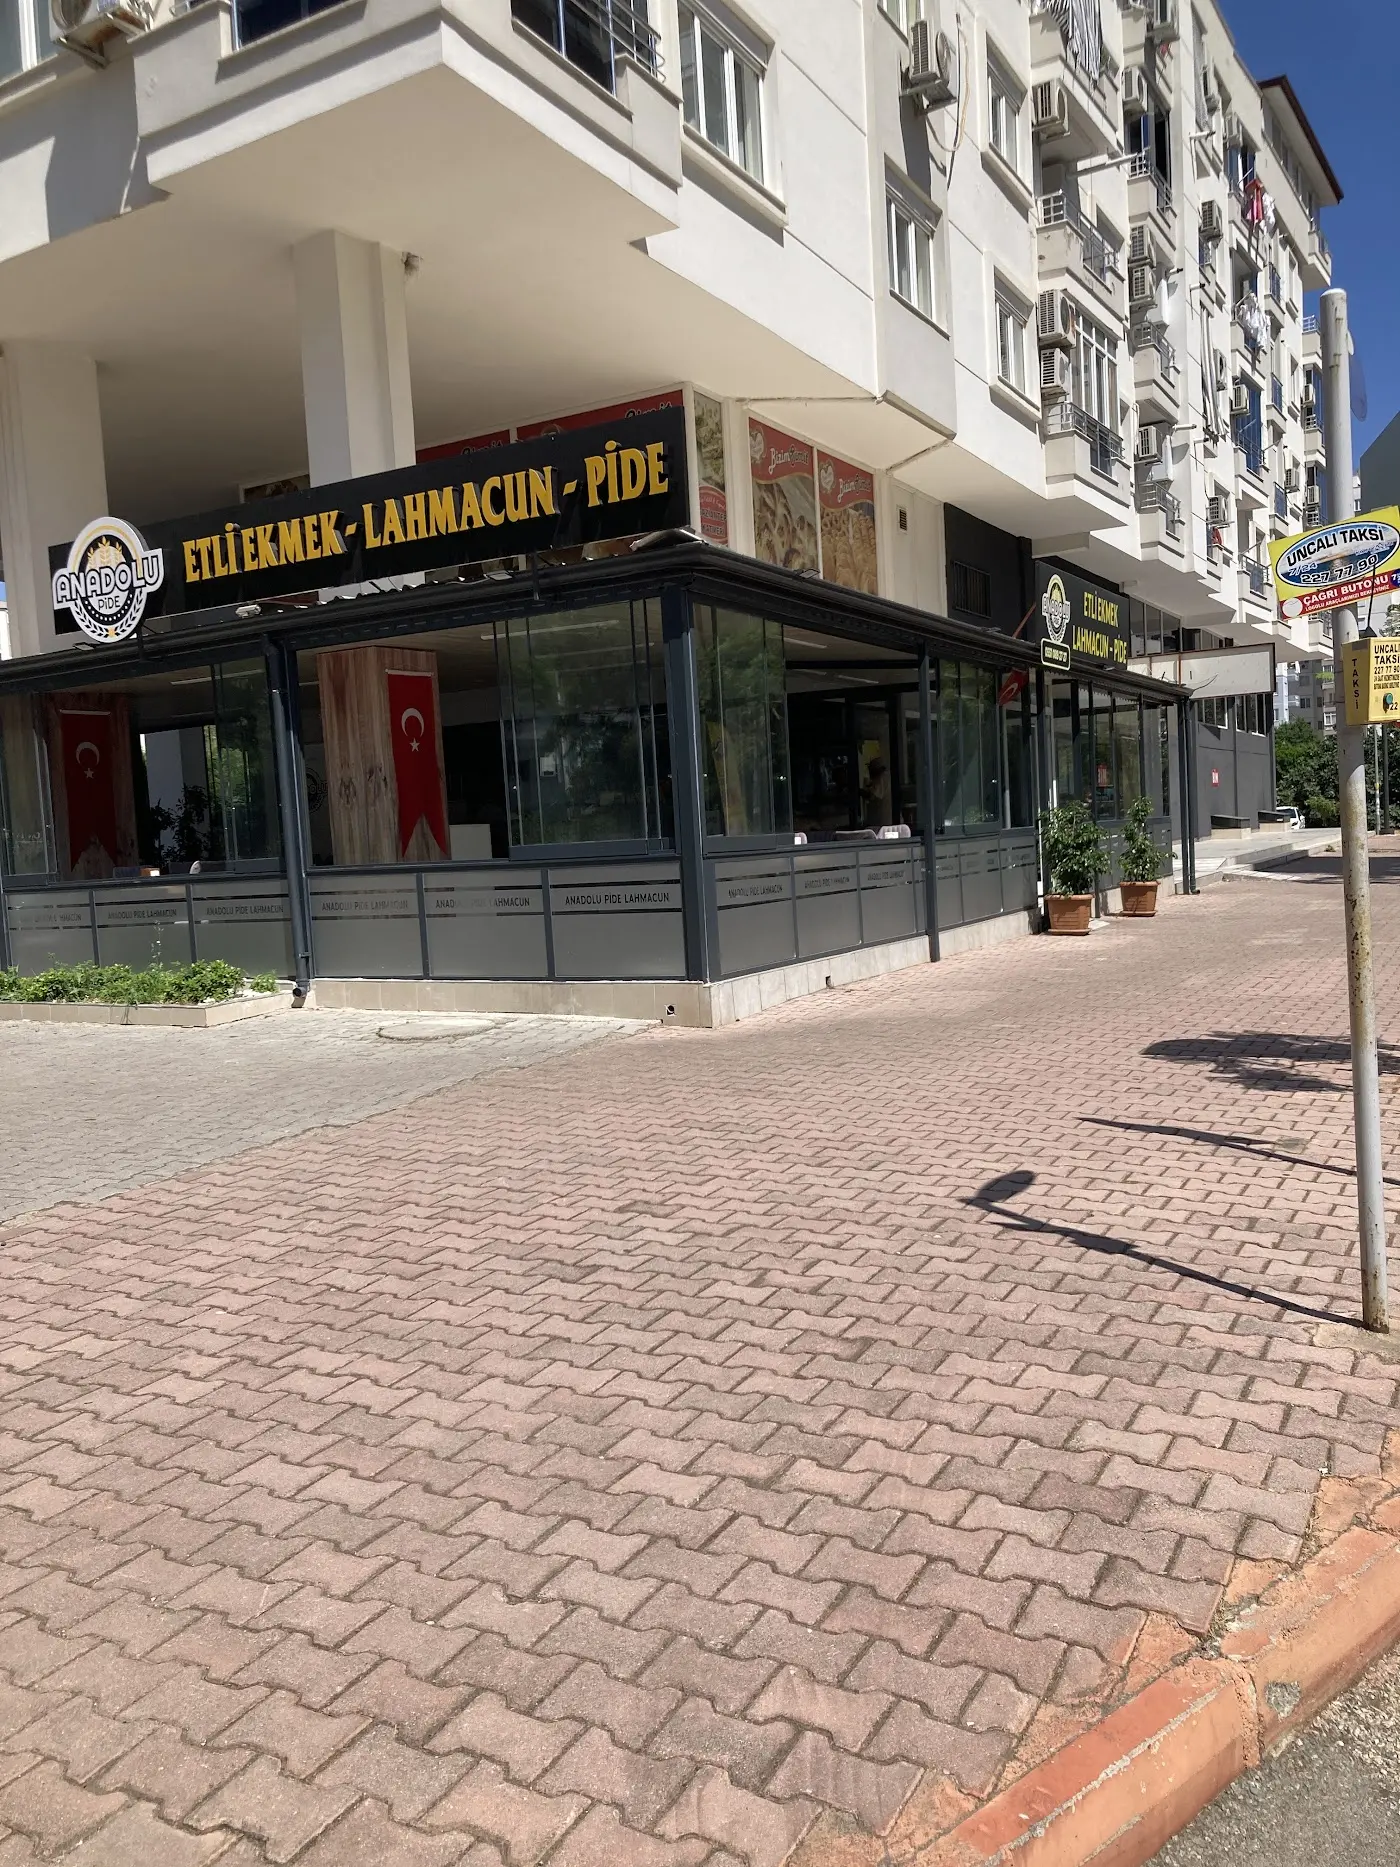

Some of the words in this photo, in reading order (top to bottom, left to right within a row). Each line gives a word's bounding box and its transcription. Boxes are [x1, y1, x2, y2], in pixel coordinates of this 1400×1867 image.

[361, 465, 557, 550] LAHMACUN
[583, 440, 669, 508] PİDE
[1286, 532, 1338, 567] UNCALI
[1340, 525, 1384, 544] TAKSİ
[55, 555, 160, 604] ANADOLU
[1301, 571, 1330, 583] 227
[1335, 564, 1354, 580] 77
[1358, 554, 1379, 571] 90
[1341, 574, 1389, 595] BUTONU
[98, 595, 121, 611] PİDE
[1072, 624, 1110, 659] LAHMACUN
[1113, 634, 1128, 665] PİDE
[1373, 666, 1384, 675] 227
[1374, 654, 1400, 665] TAKSİ
[1351, 658, 1360, 710] TAKSİ
[206, 905, 234, 916] ANADOLU
[249, 903, 285, 914] LAHMACUN
[565, 894, 602, 906] ANADOLU
[604, 891, 622, 904] PİDE
[624, 892, 670, 904] LAHMACUN
